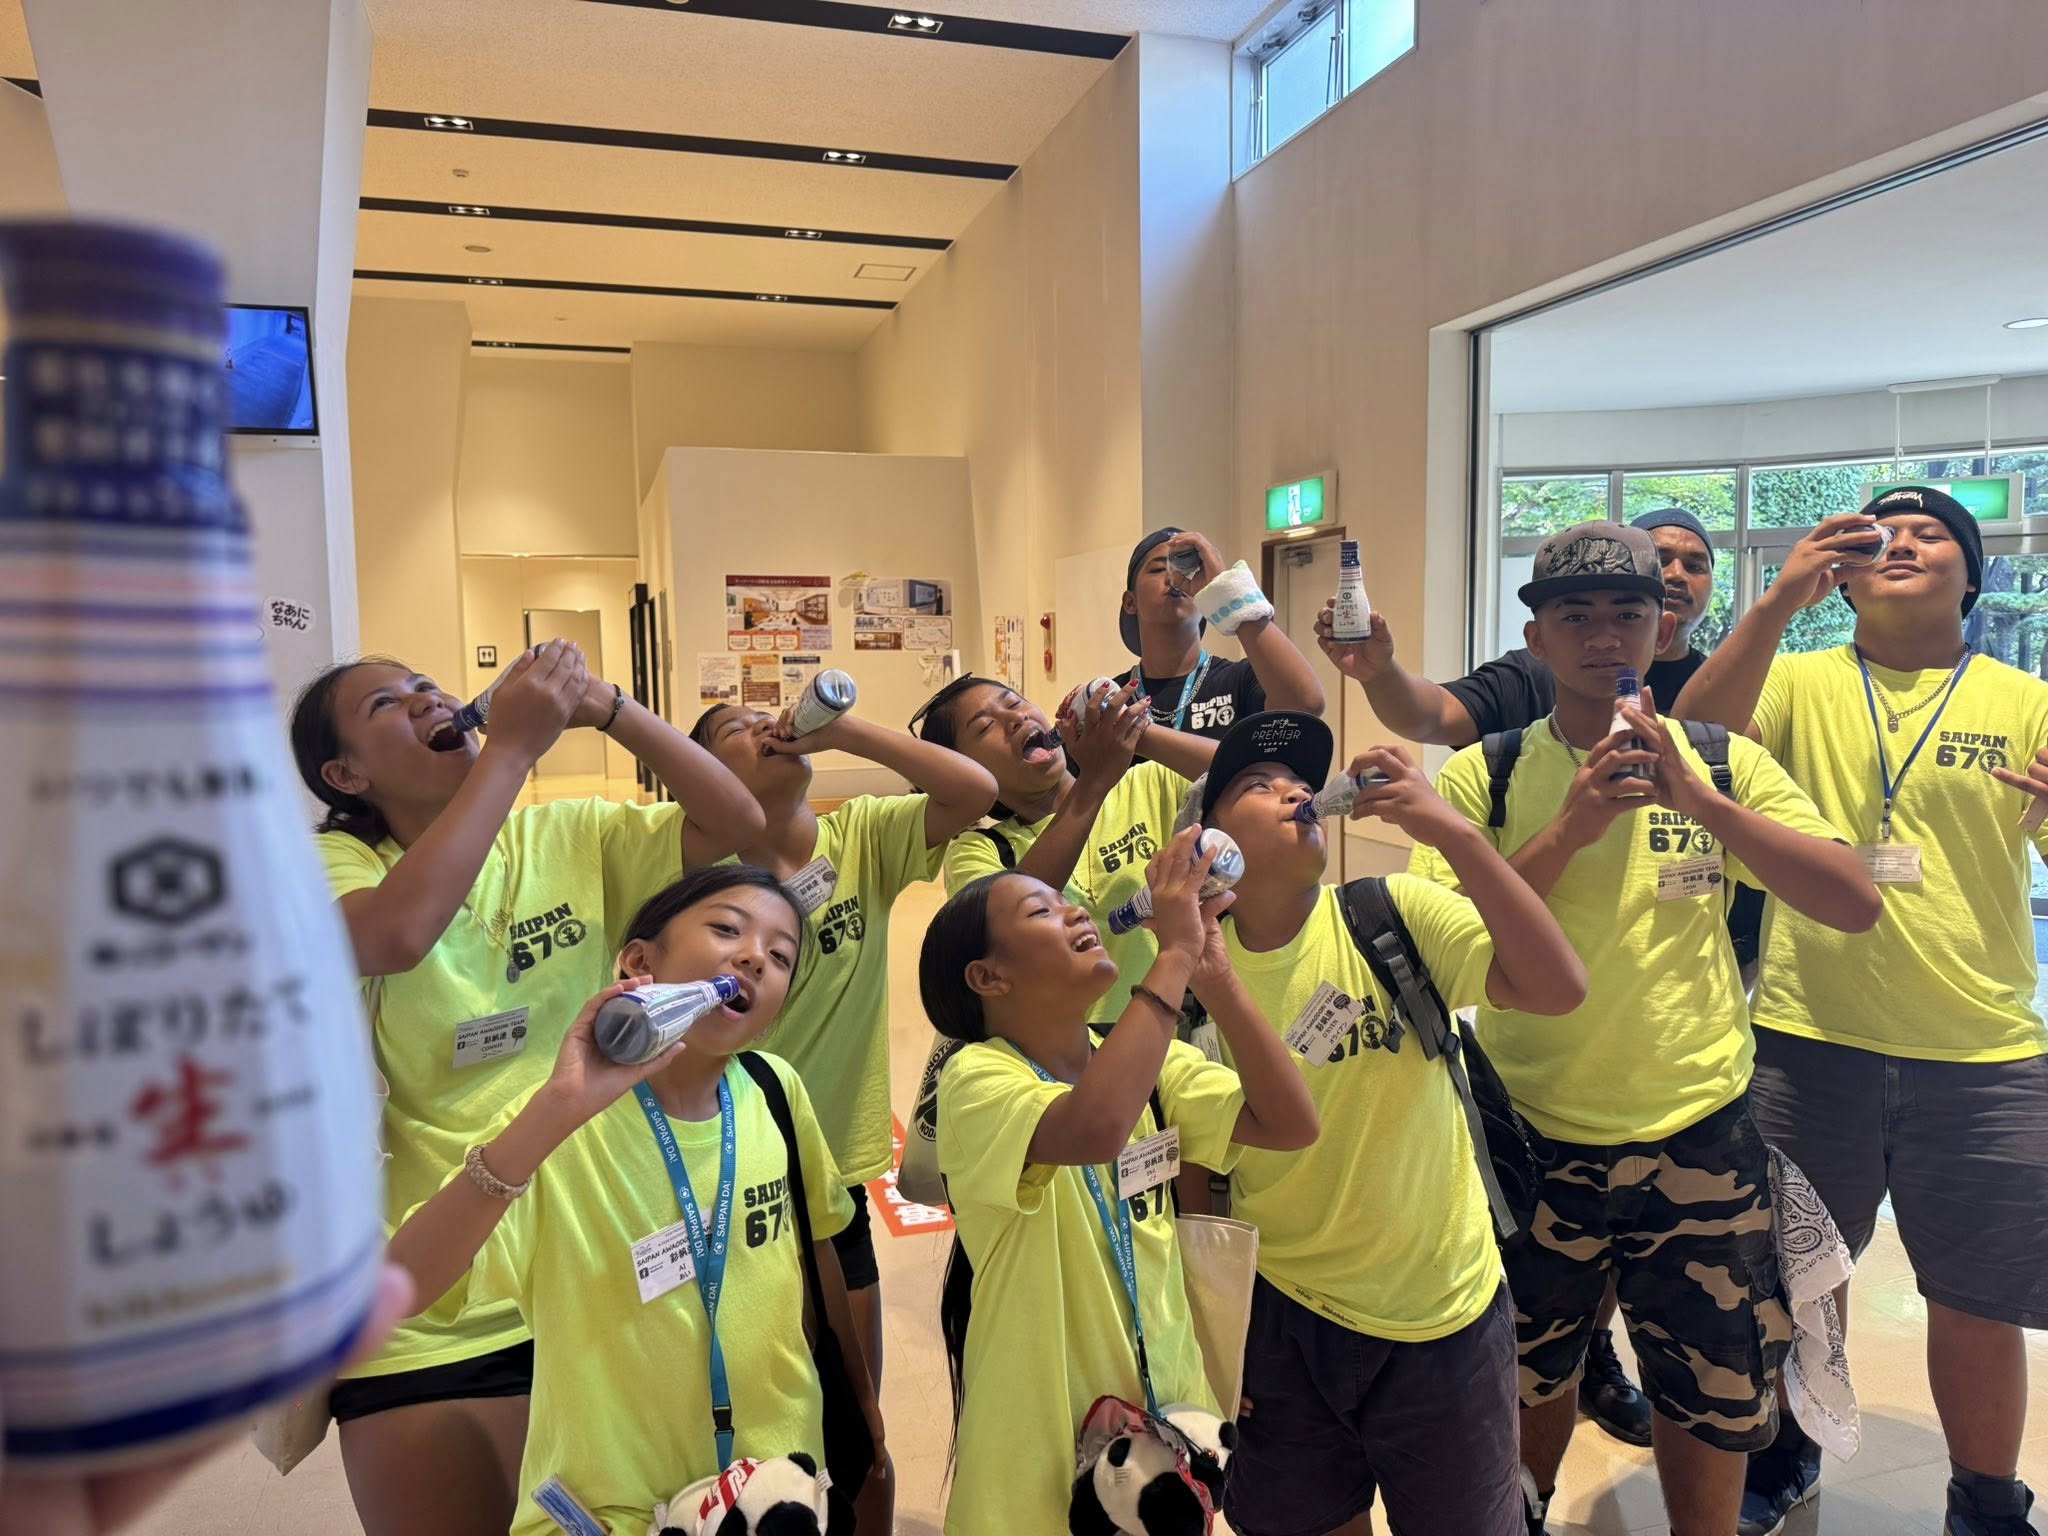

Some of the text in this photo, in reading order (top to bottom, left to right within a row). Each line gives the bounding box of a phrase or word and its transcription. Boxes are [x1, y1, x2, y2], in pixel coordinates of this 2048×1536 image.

[271, 601, 310, 620] なあに
[272, 614, 307, 630] ちゃん
[1191, 694, 1233, 712] SAIPAN
[1939, 731, 2007, 748] SAIPAN
[1098, 822, 1148, 856] SAIPAN
[509, 902, 573, 940] SAIPAN
[1324, 990, 1337, 1007] TEAM
[22, 979, 312, 1064] しぼりたて
[128, 1049, 250, 1172] 生
[723, 1087, 734, 1138] SAIPAN DA!
[650, 1111, 679, 1164] SAIPAN DA!
[89, 1181, 293, 1268] しょうゆ
[717, 1180, 732, 1237] SAIPAN DA!
[685, 1202, 706, 1258] SAIPAN DA!
[637, 1251, 660, 1268] SAIPAN
[679, 1263, 687, 1271] AI
[1115, 1243, 1129, 1278] SAIPAN
[1123, 1234, 1133, 1269] SAIPAN
[680, 1270, 691, 1281] あい
